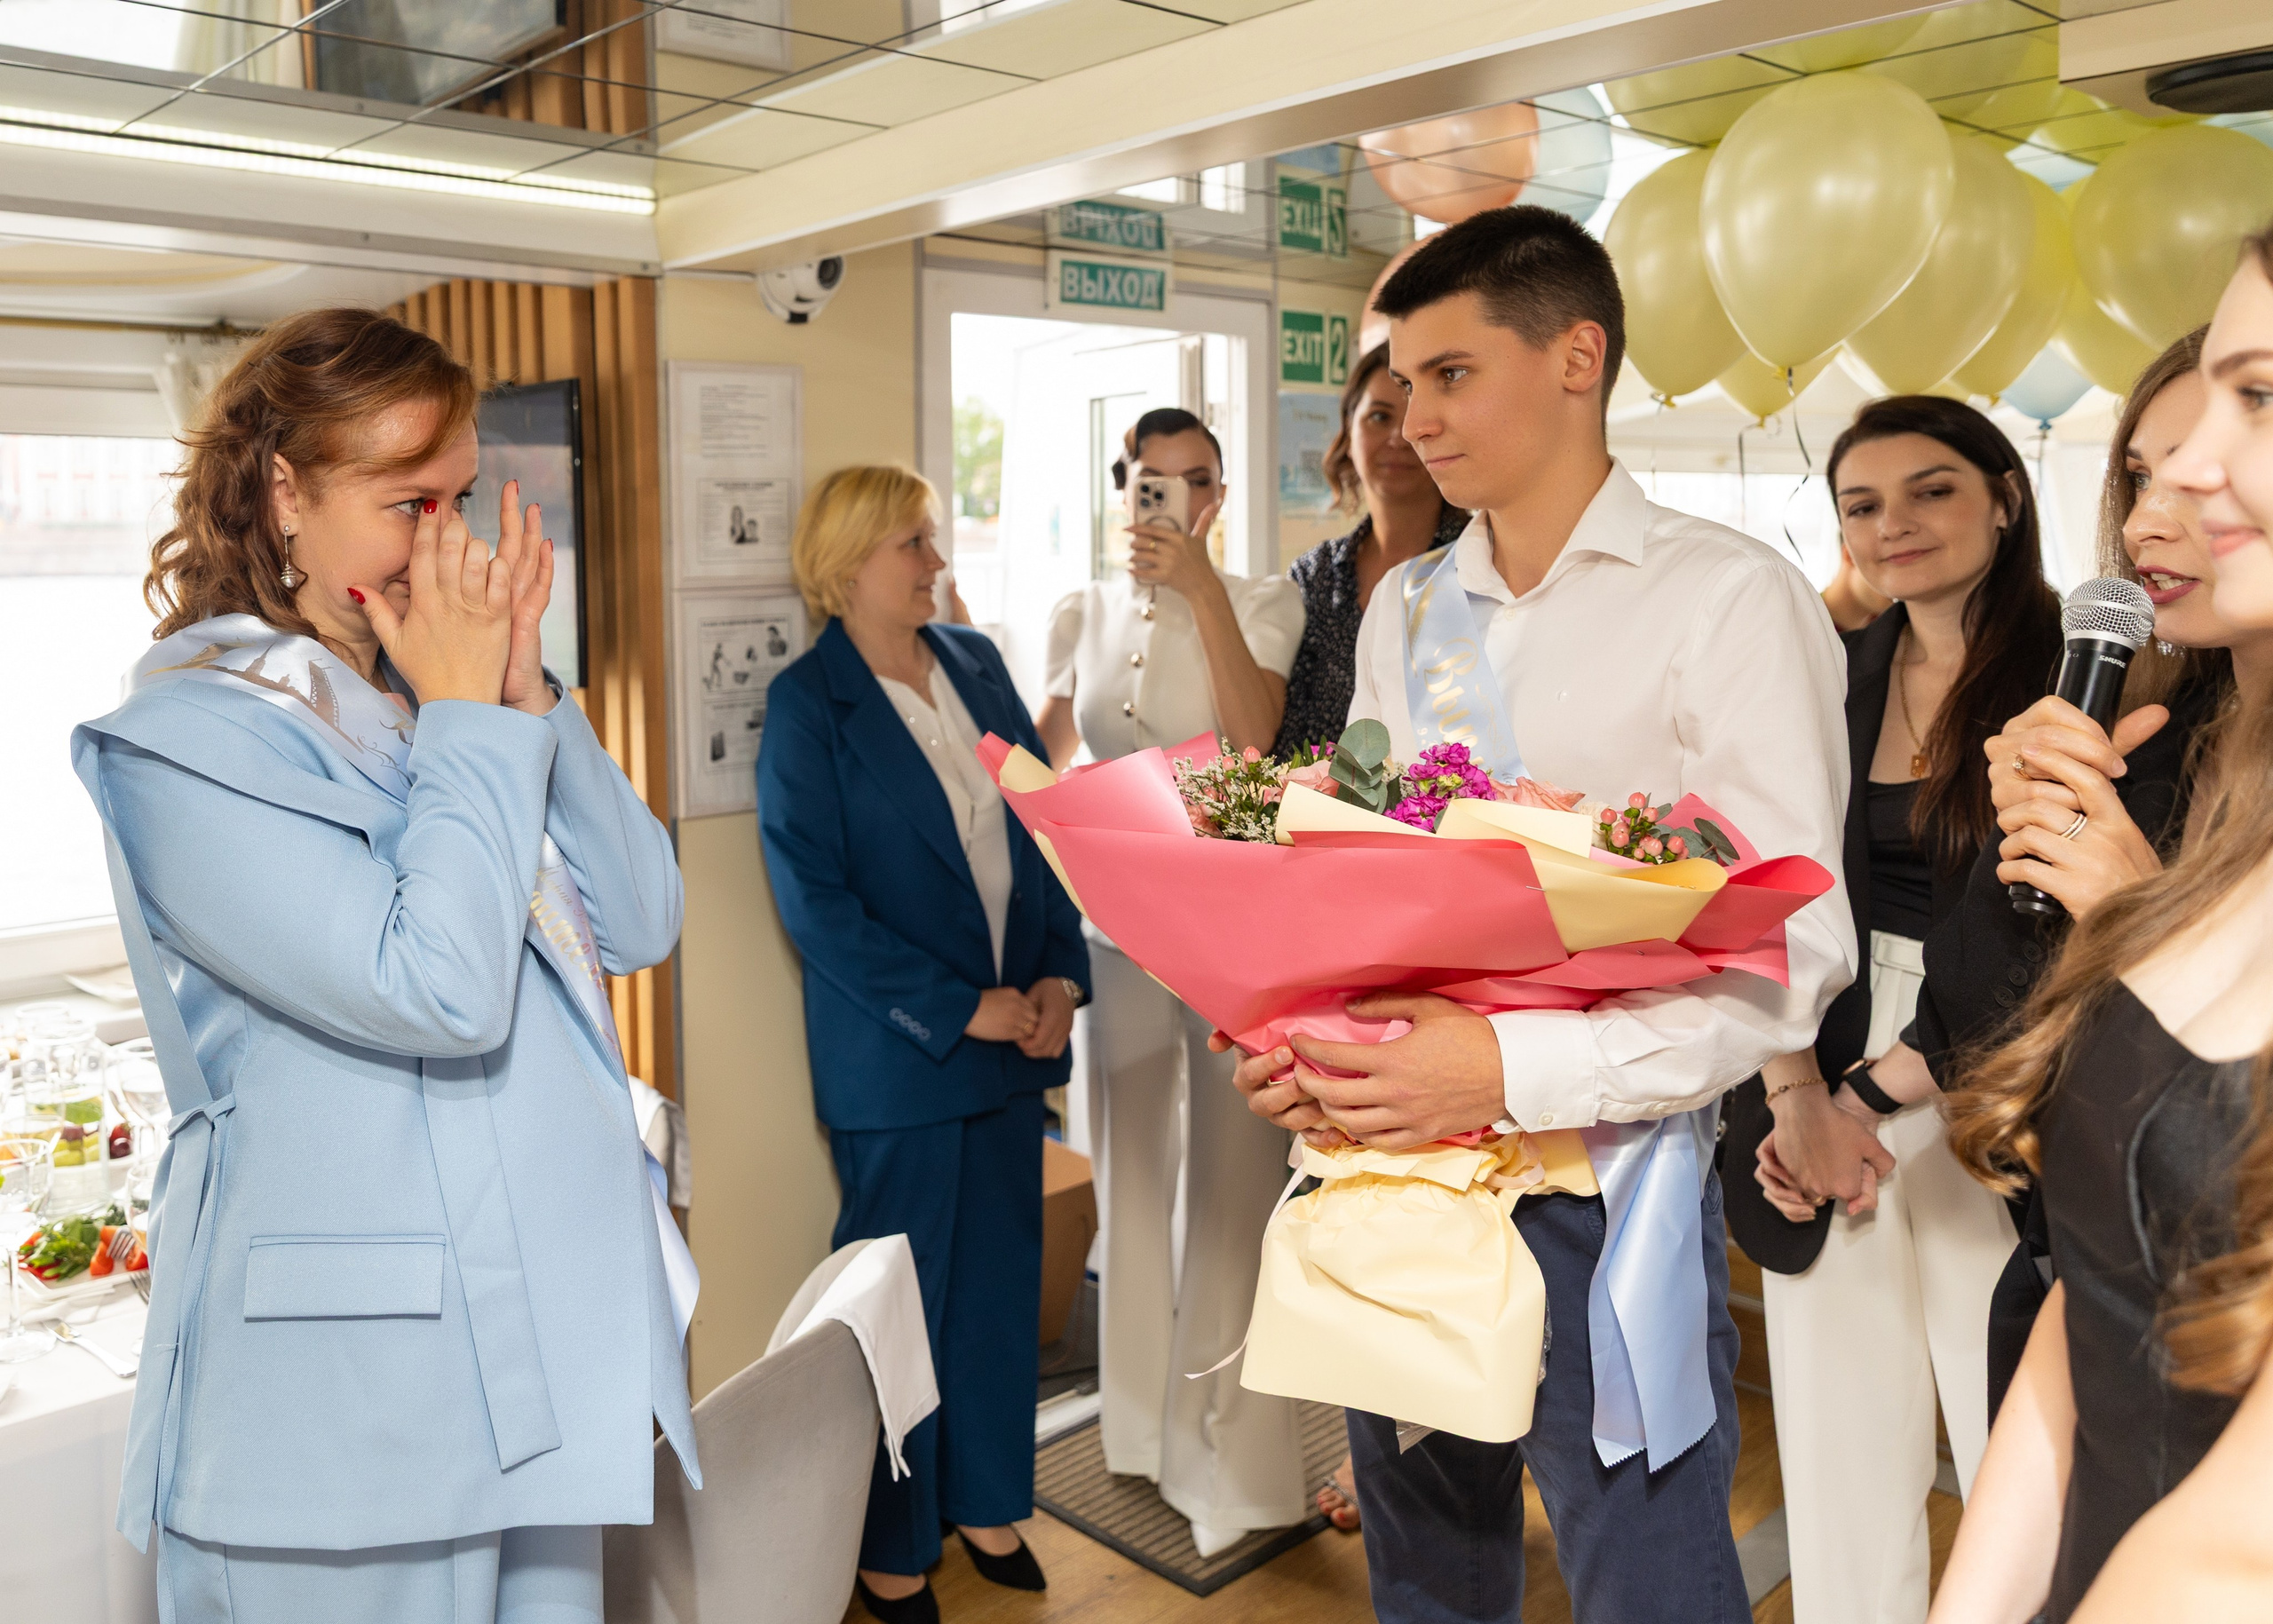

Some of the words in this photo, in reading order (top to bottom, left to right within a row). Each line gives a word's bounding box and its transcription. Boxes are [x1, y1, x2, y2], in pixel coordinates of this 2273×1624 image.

[1064, 265, 1159, 305] ВЫХОД
[1280, 329, 1321, 365] EXIT
[1331, 321, 1344, 381] 2
[2097, 654, 2126, 669] SHURE
